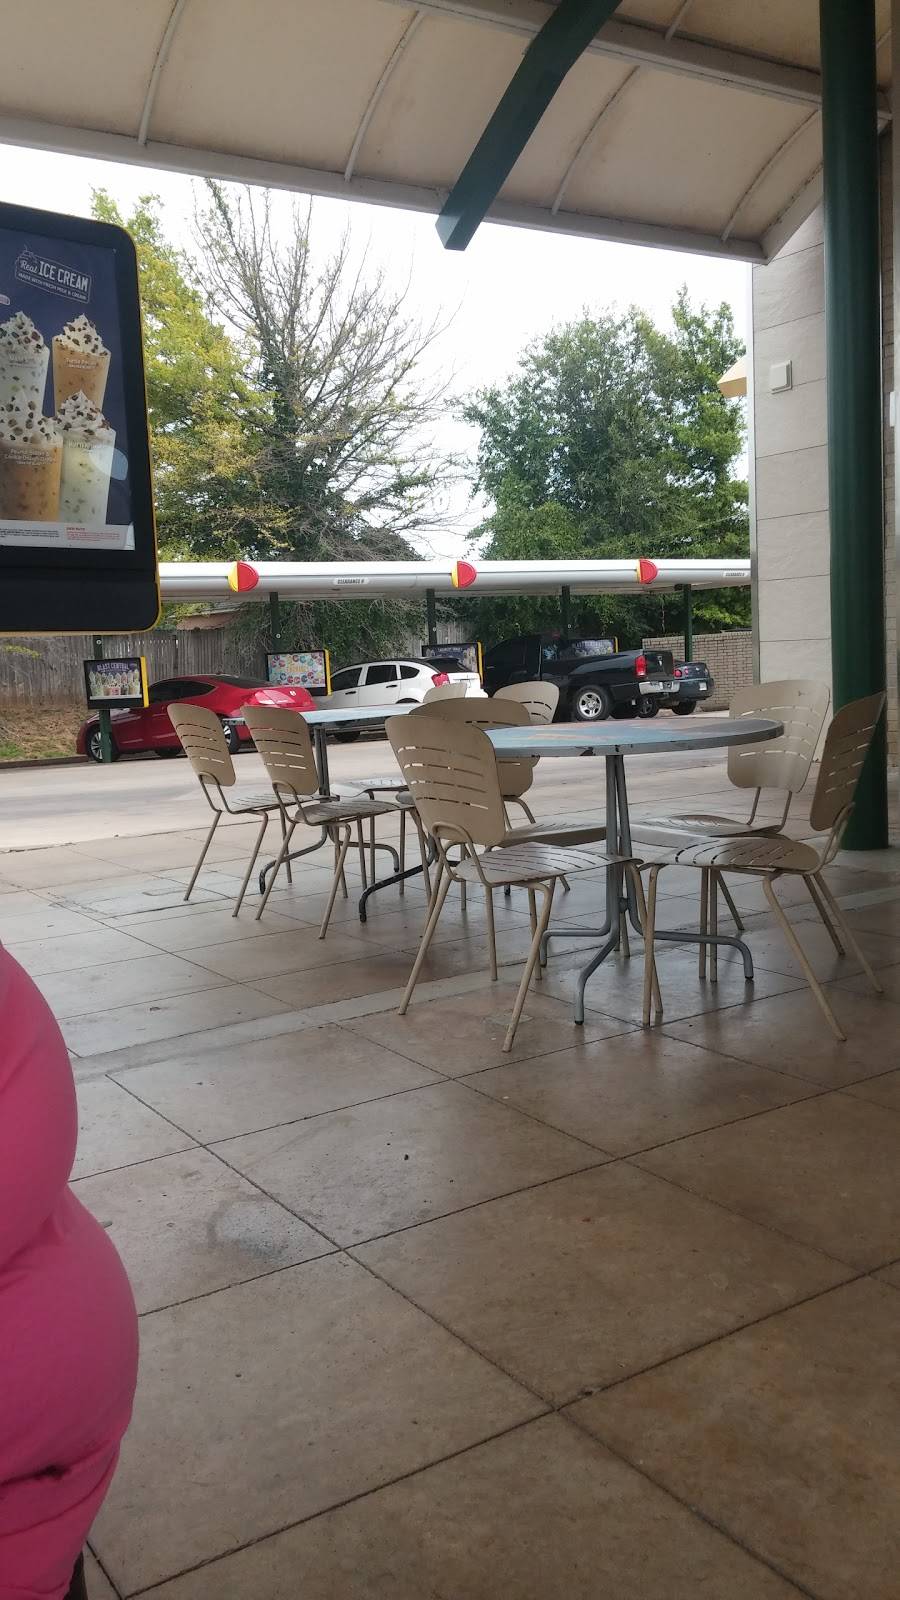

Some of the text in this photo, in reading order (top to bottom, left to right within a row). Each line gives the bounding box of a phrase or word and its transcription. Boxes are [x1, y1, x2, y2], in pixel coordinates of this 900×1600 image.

[21, 260, 89, 292] Real ICE CREAM
